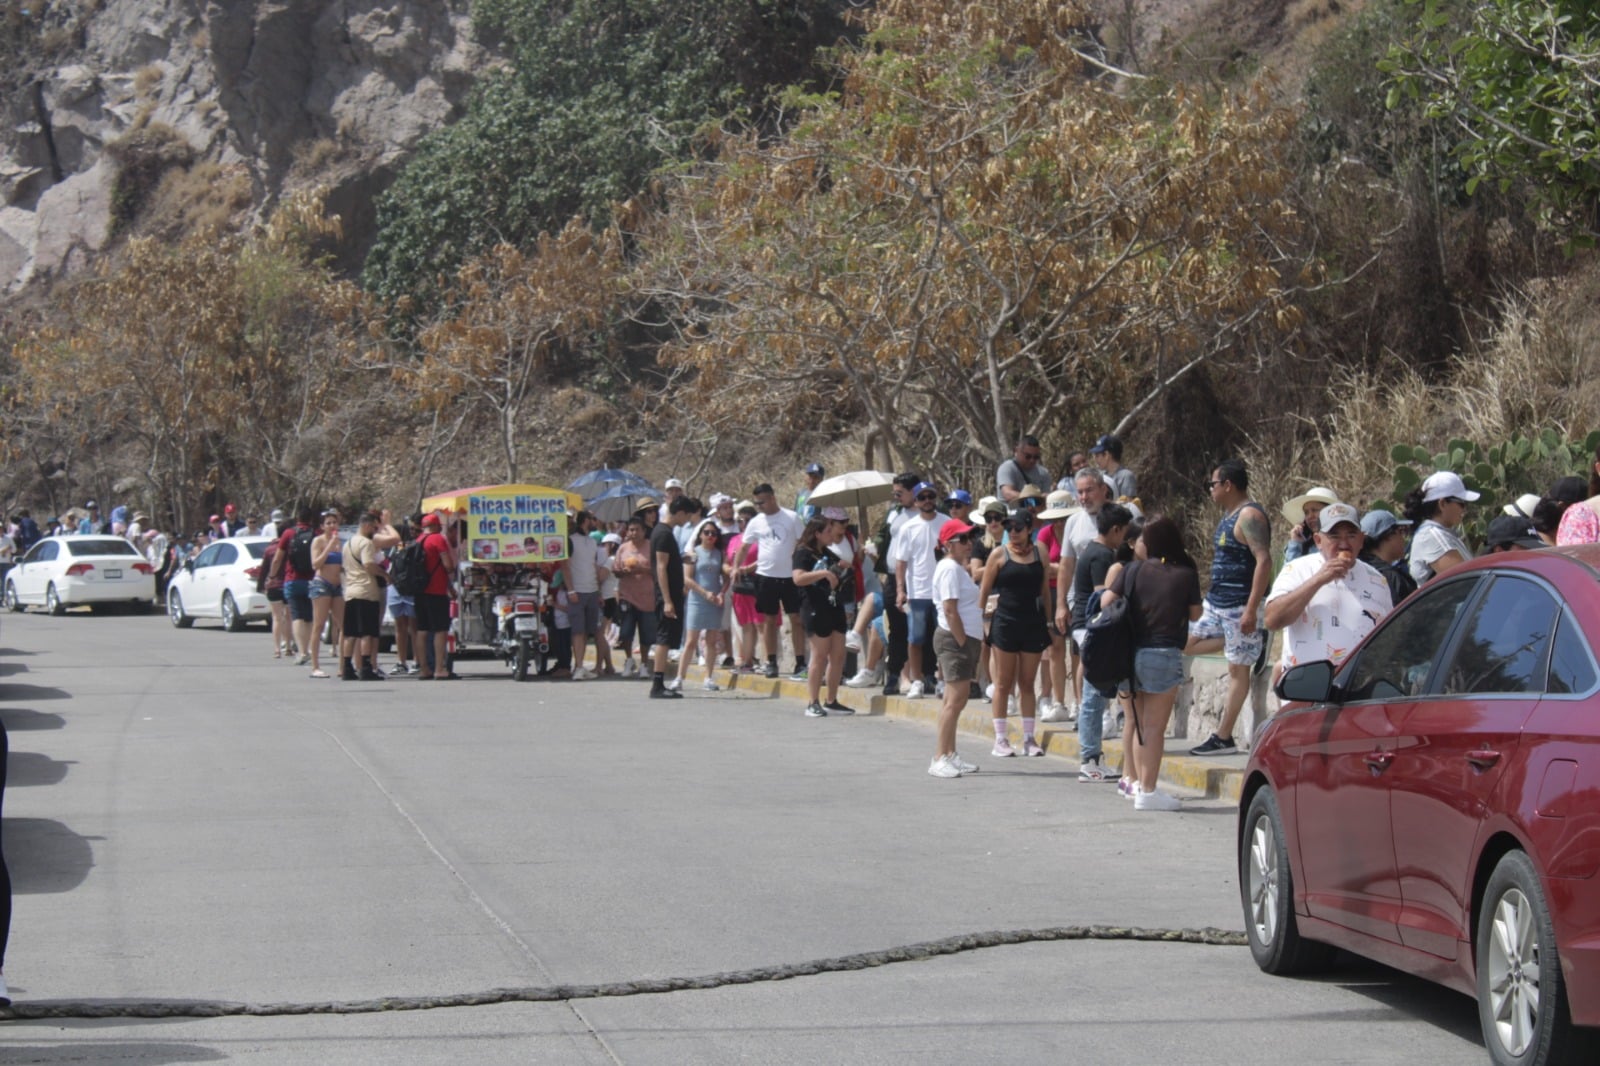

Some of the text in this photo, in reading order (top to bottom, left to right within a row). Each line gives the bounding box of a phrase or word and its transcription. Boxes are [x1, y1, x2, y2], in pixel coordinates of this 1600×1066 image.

[470, 496, 565, 515] Ricas Nieves
[479, 515, 556, 535] de Garrafa
